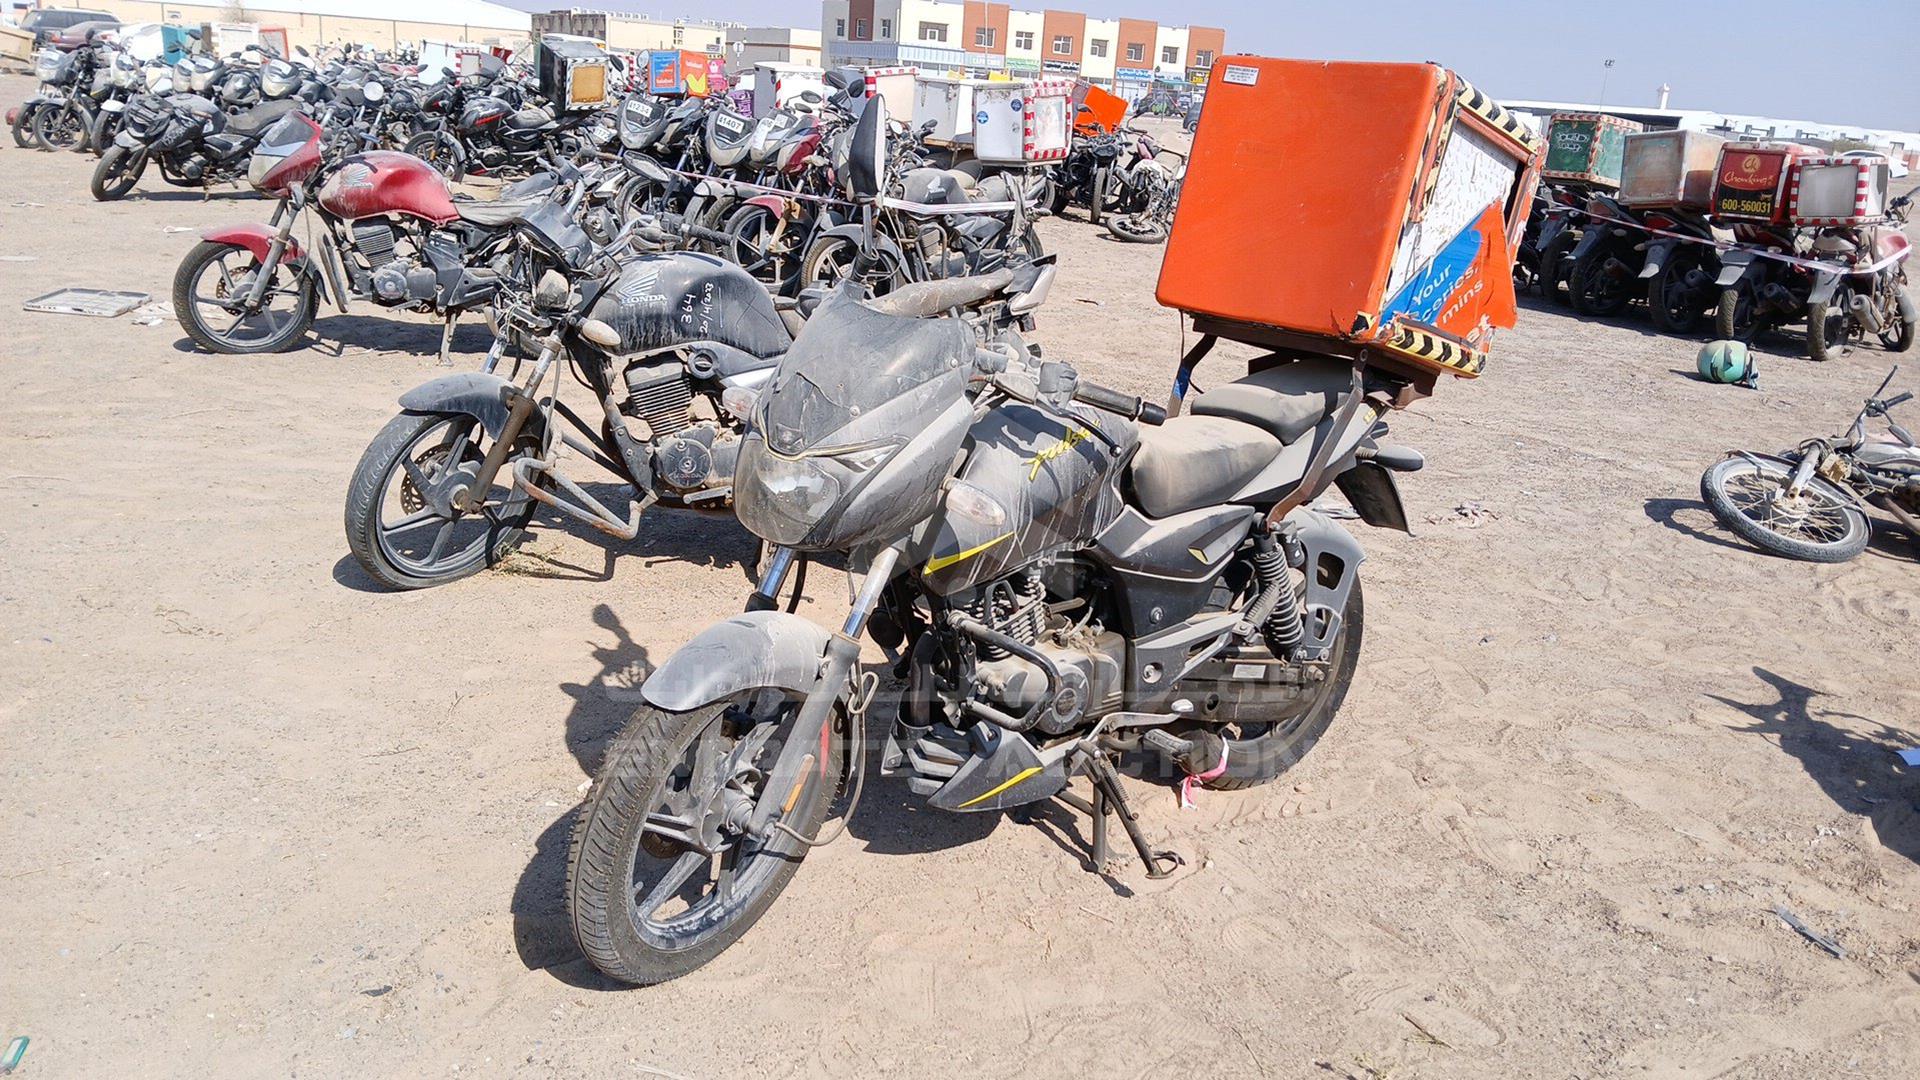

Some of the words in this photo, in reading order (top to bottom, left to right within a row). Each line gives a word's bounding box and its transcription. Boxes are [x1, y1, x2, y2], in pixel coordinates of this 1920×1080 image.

[1722, 198, 1771, 214] 600-560031
[620, 293, 668, 305] HONDA
[1412, 263, 1452, 306] Your
[680, 293, 696, 324] 364
[1441, 279, 1485, 324] mins
